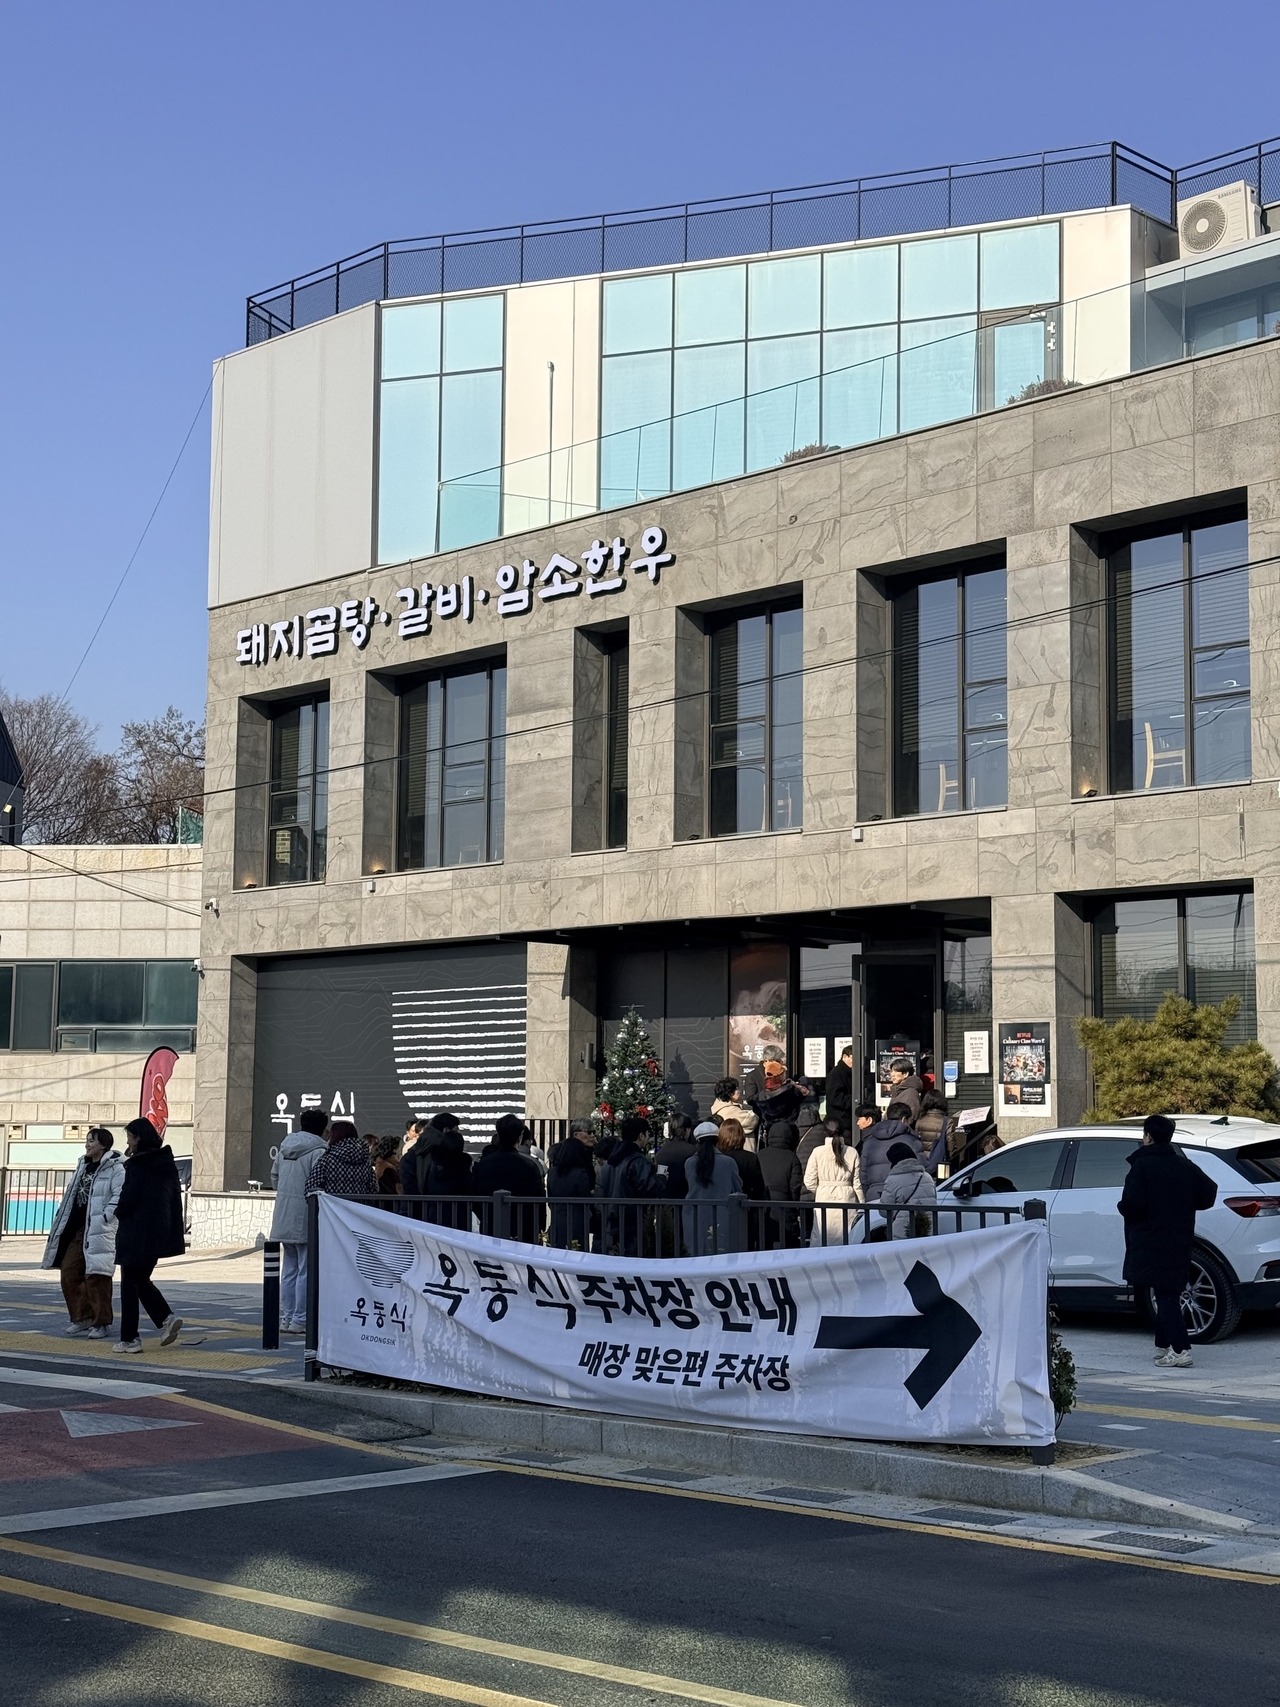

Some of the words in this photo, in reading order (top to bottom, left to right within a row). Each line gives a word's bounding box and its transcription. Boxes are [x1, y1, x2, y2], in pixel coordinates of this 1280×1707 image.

[742, 1045, 764, 1060] 옥동
[350, 1297, 408, 1333] 옥동식
[704, 1276, 798, 1336] 안내
[360, 1334, 397, 1346] OKDONGSIK
[578, 1341, 631, 1379] 매장
[632, 1346, 709, 1387] 맞은편
[711, 1353, 791, 1392] 주차장
